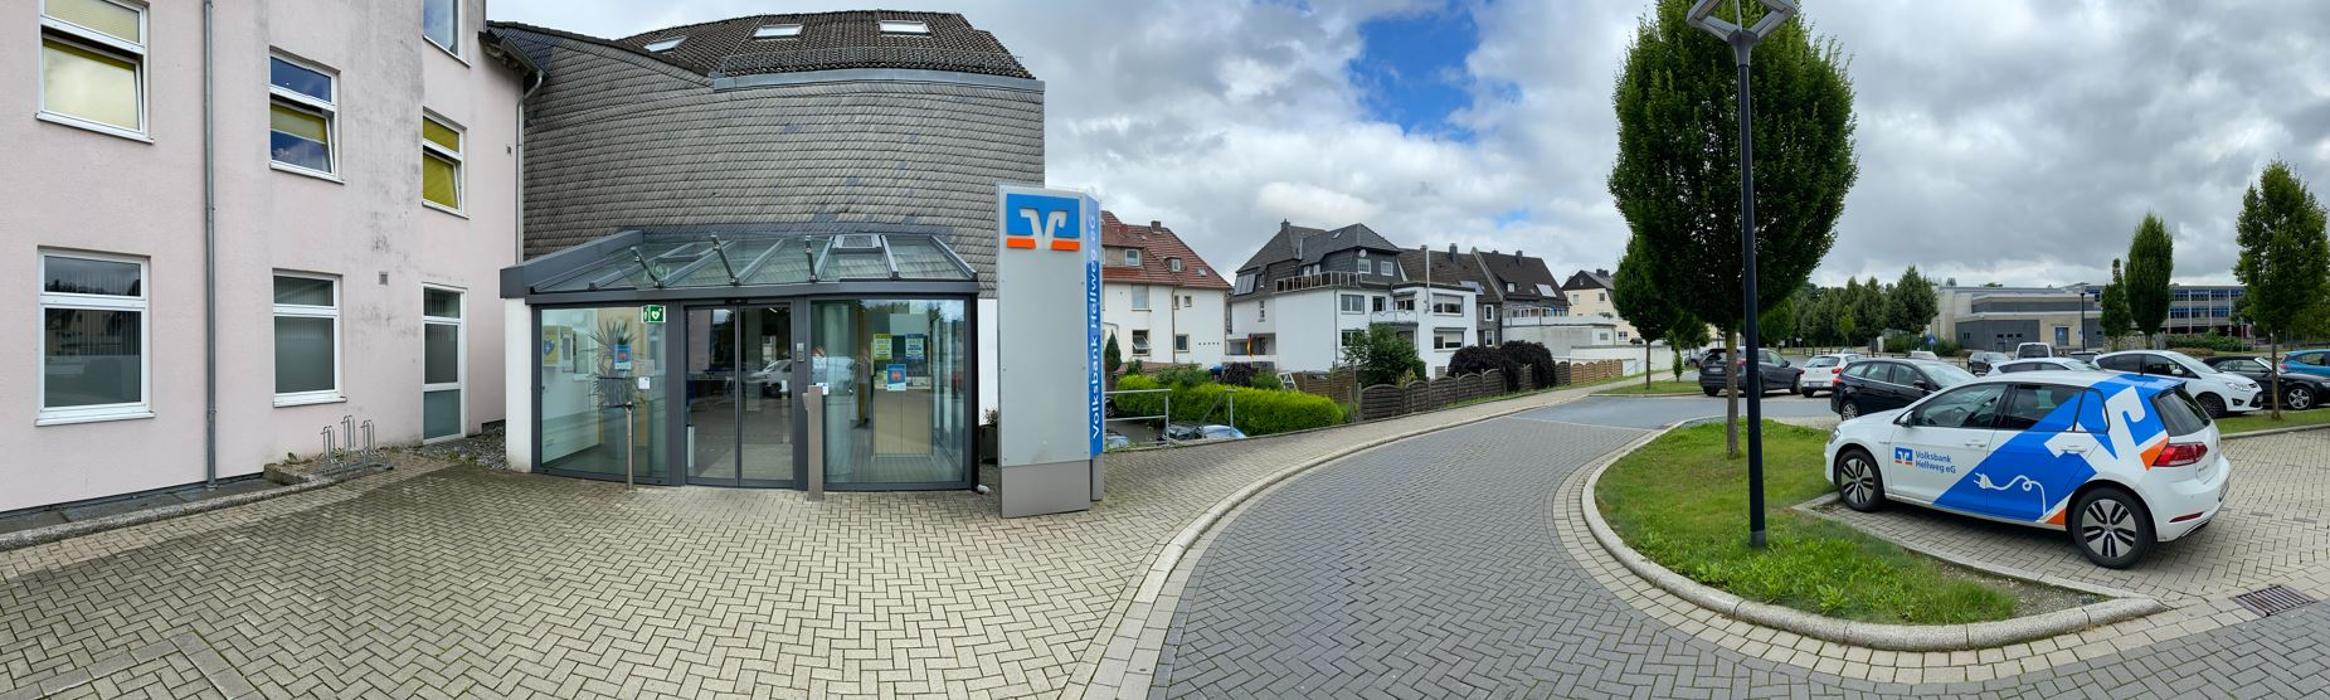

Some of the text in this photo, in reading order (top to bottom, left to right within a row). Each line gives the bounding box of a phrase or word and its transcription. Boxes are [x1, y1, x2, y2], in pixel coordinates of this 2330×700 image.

[1090, 249, 1098, 329] Hellweg
[1090, 336, 1100, 439] Volksbank
[1915, 450, 1951, 463] Volksbank
[1915, 460, 1956, 473] Hellweg eG
